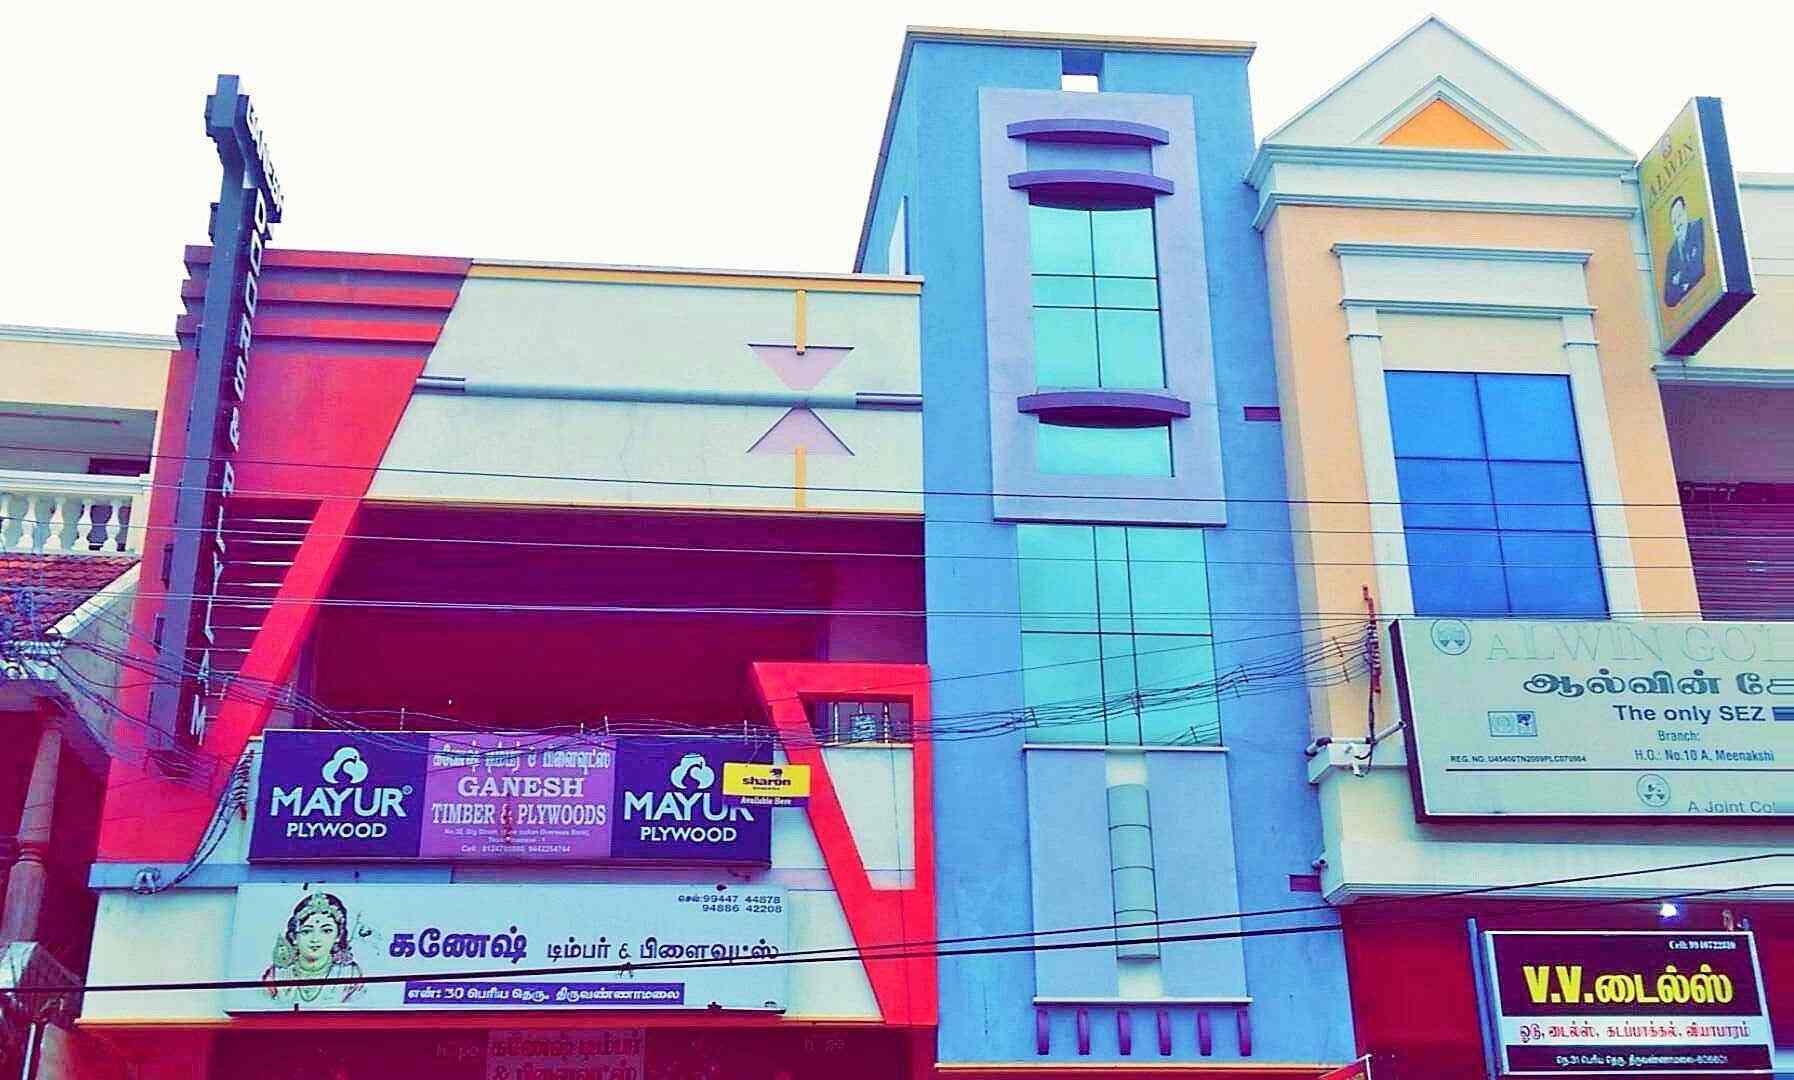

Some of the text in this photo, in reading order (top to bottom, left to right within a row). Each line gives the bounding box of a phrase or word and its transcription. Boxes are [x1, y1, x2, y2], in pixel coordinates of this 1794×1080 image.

[234, 187, 267, 402] DOORS
[1487, 624, 1665, 662] ALWIN
[1523, 668, 1722, 697] ஆல்வின்
[1613, 704, 1766, 725] The only SEZ
[1658, 730, 1701, 742] Branch:
[1715, 749, 1775, 762] Meenakshi
[458, 776, 585, 798] GANESH
[742, 775, 792, 787] sharon
[270, 785, 407, 818] MAYUR
[1687, 801, 1700, 813] A
[1704, 801, 1745, 813] Joint
[432, 803, 496, 825] TIMBER
[517, 804, 607, 827] PLYWOODS
[286, 822, 388, 839] PLYWOOD
[640, 826, 738, 843] PLYWOOD
[745, 904, 783, 914] 42208
[389, 925, 528, 964] கணேஷ்
[547, 936, 612, 963] டிம்பர்
